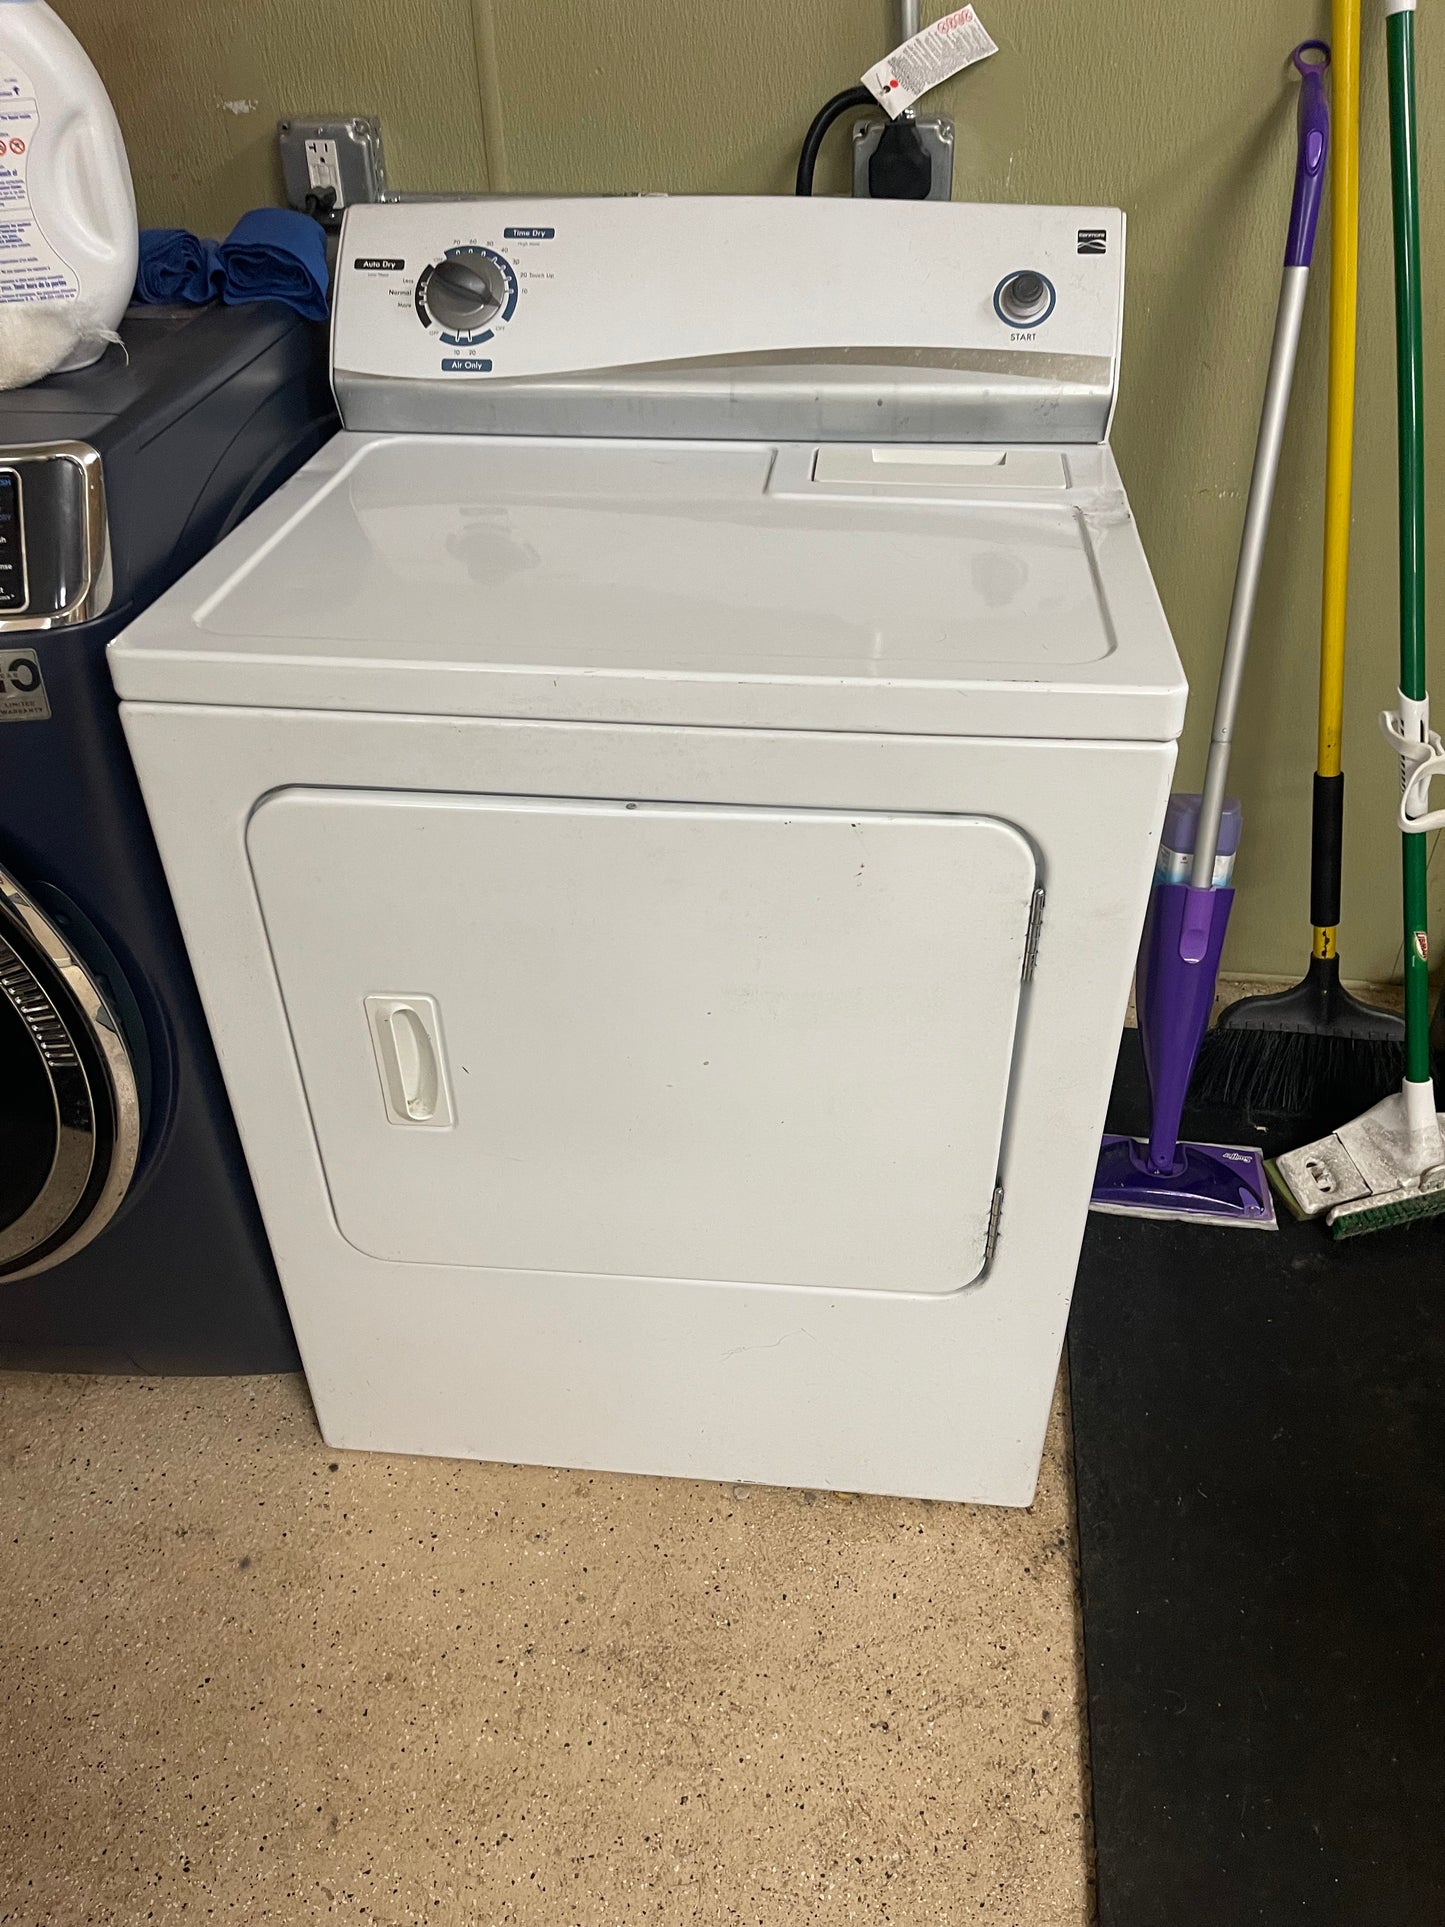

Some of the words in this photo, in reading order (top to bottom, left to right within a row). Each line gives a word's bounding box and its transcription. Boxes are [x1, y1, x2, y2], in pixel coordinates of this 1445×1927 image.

[513, 229, 530, 237] Time
[532, 229, 546, 239] Dry
[363, 260, 381, 269] Auto
[382, 260, 396, 270] Dry
[1010, 333, 1036, 341] START
[451, 361, 462, 370] Air
[464, 361, 482, 371] Only
